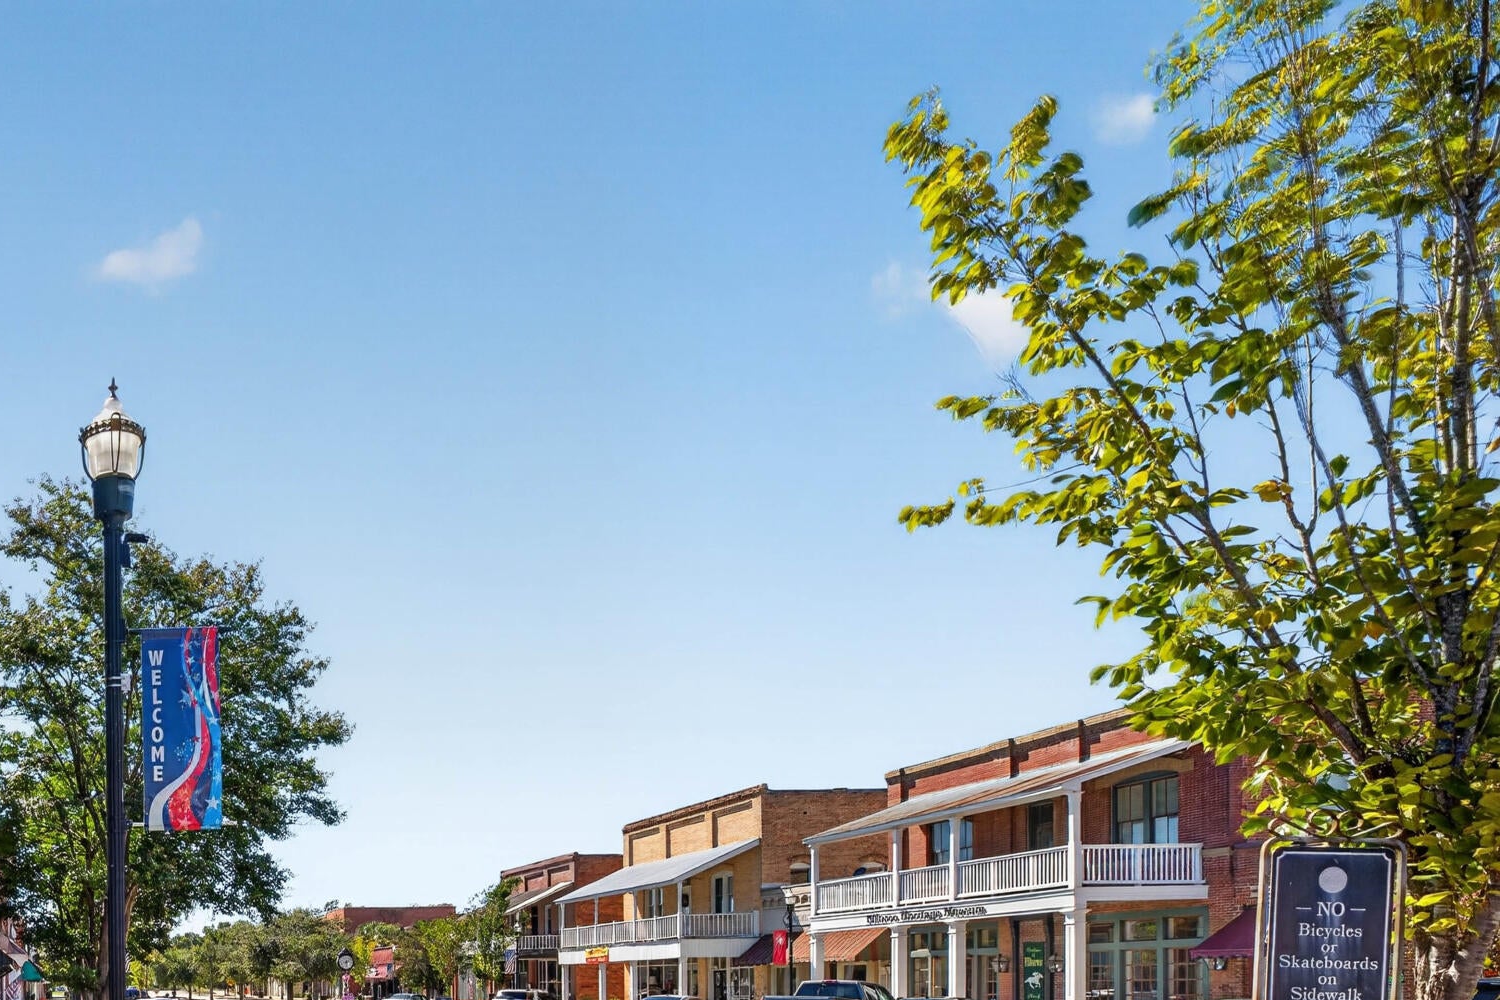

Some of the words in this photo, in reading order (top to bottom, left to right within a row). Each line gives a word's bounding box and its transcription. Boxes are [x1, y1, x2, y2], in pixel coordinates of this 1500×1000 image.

[148, 650, 165, 782] WELCOME
[1316, 902, 1345, 917] NO
[1299, 922, 1363, 939] Bicycles
[1321, 943, 1338, 953] or
[1279, 954, 1379, 970] Skateboards
[1318, 975, 1337, 985] on
